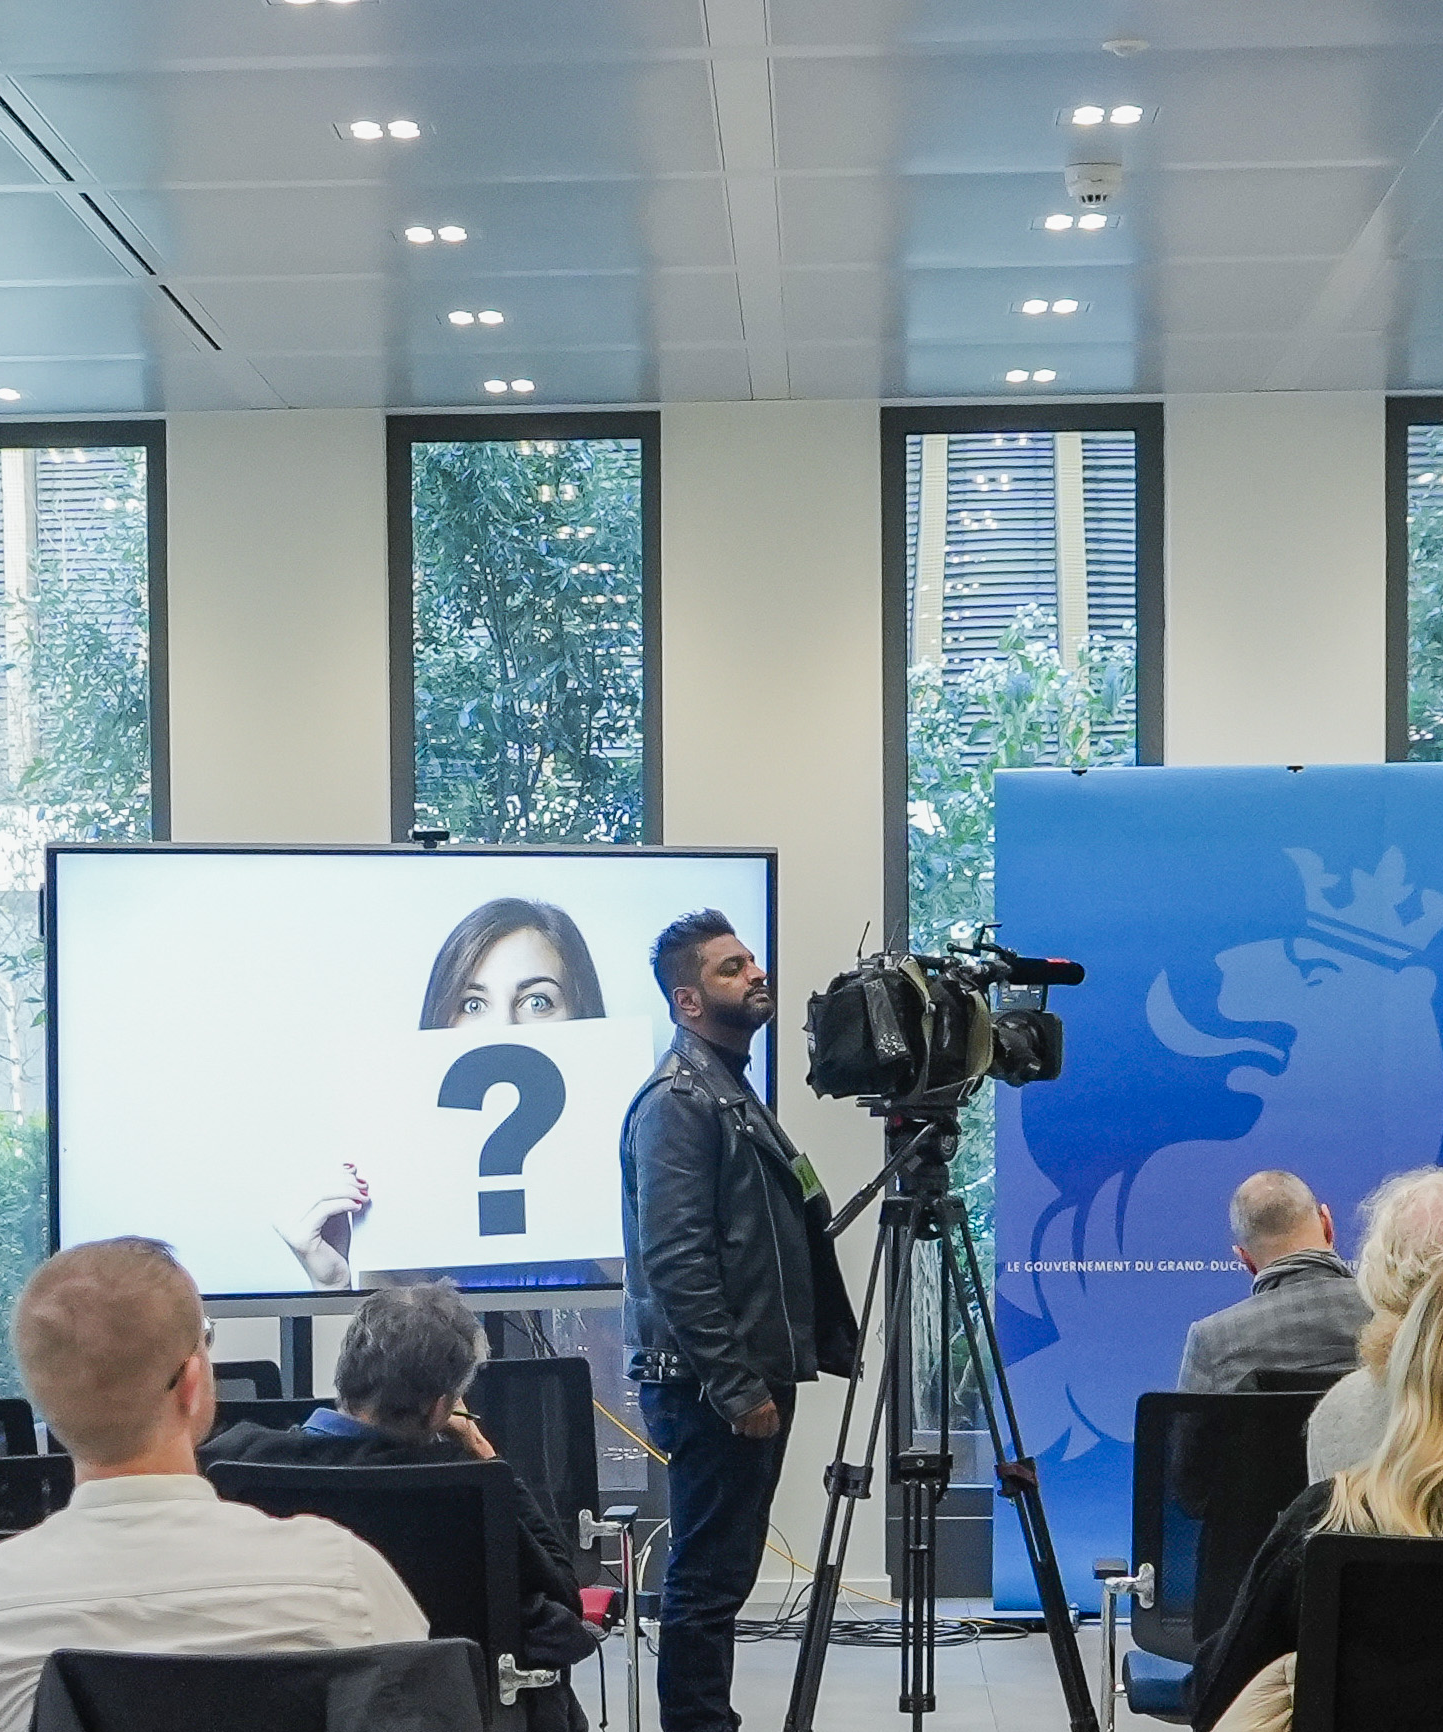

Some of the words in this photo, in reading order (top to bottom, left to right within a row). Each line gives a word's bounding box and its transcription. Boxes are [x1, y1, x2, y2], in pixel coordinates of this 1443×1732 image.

[1007, 1261, 1020, 1273] LE
[1024, 1260, 1132, 1273] GOUVERNEMENT
[1135, 1260, 1154, 1272] DU
[1158, 1260, 1247, 1273] GRAND-DUCH
